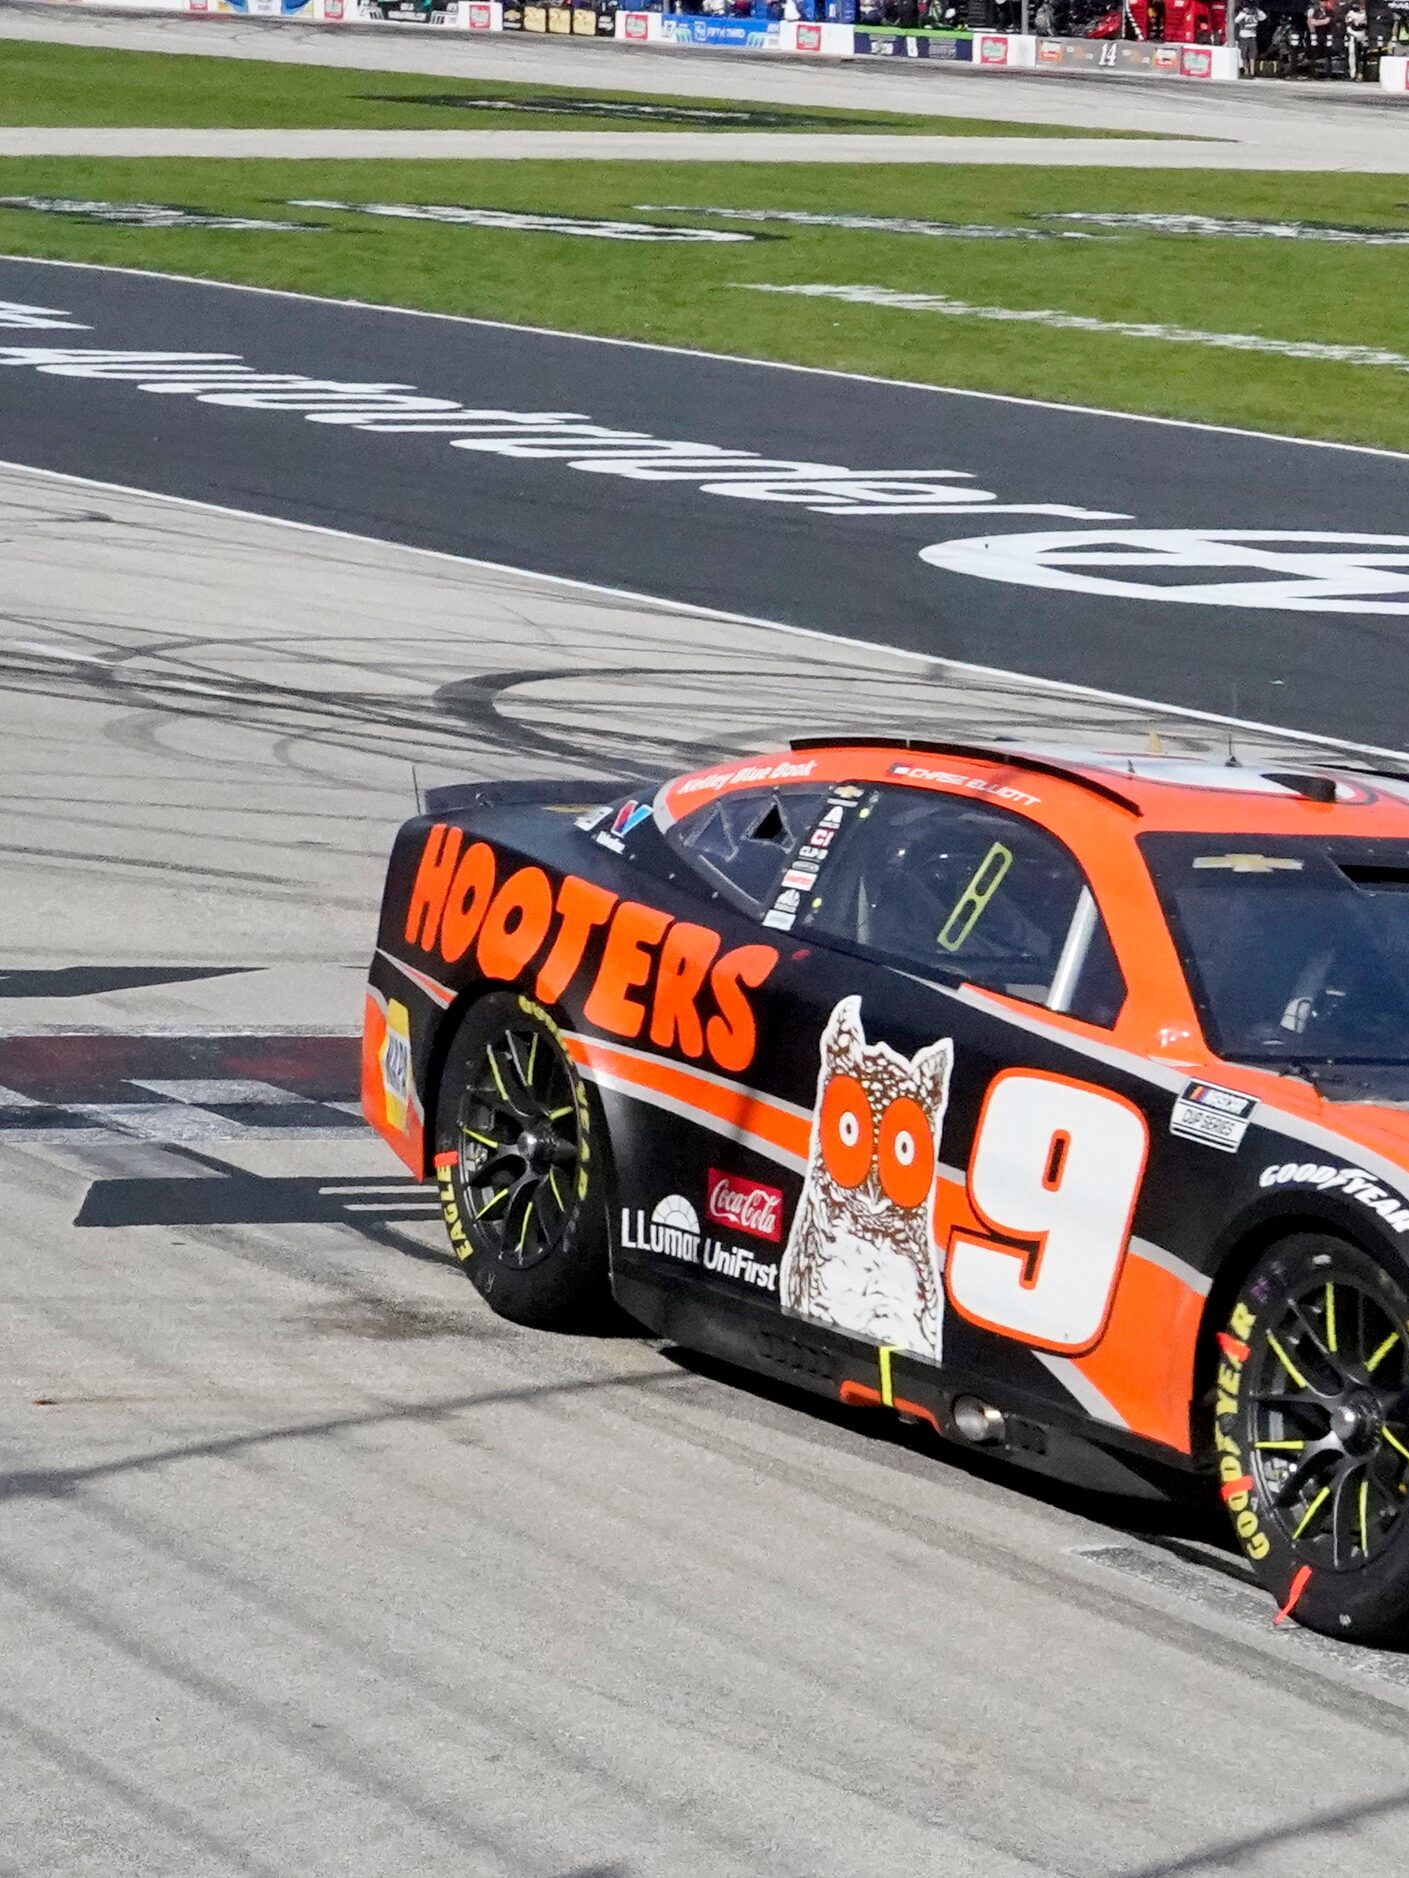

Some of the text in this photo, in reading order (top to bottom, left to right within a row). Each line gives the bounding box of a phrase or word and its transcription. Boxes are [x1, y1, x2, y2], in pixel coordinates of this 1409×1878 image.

[1099, 43, 1117, 66] 14
[729, 766, 773, 784] Blue
[768, 760, 818, 778] Book
[908, 767, 1041, 806] CHASE ELLIOTT
[405, 823, 779, 1072] HOOTERS
[434, 1164, 474, 1262] EAGLE
[945, 1066, 1150, 1358] 9
[703, 1237, 779, 1291] UniFirst
